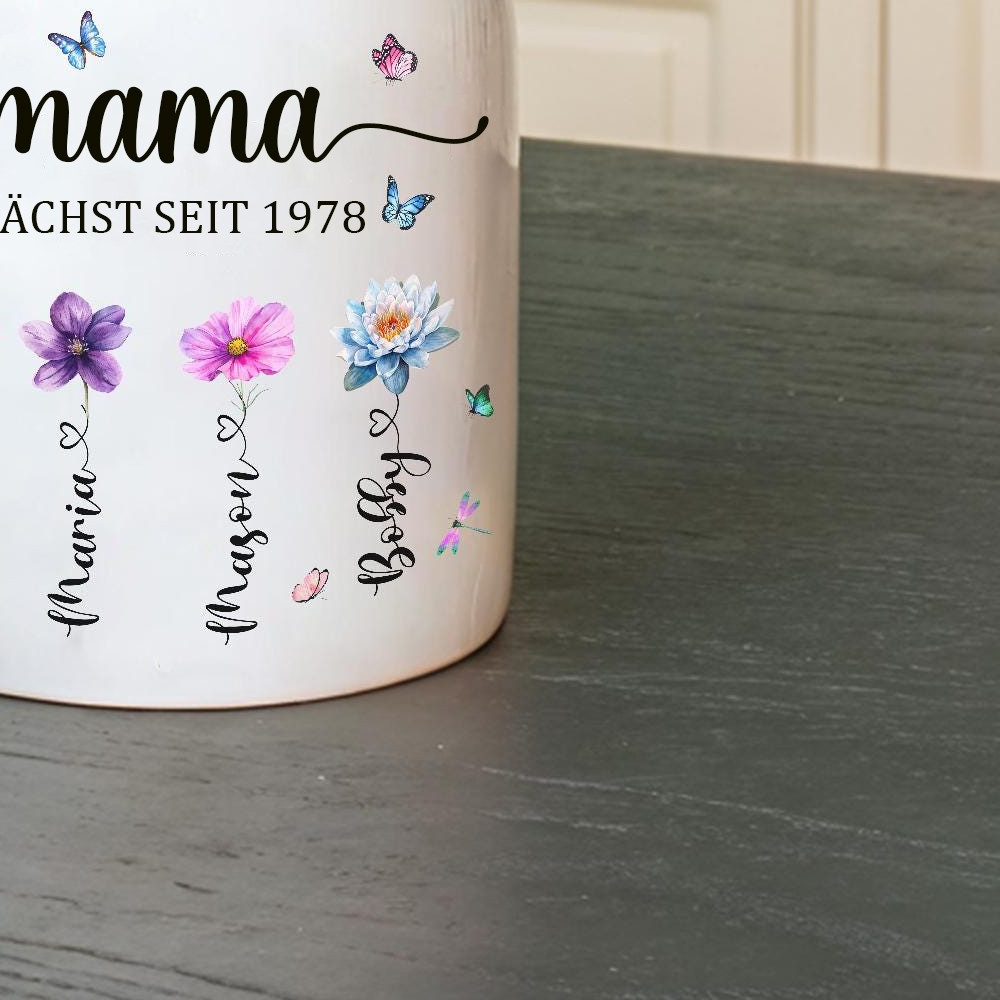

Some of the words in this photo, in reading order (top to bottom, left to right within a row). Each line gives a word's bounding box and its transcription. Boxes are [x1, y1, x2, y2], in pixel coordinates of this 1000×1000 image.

[155, 200, 249, 234] SEIT
[264, 200, 366, 234] 1978
[47, 467, 102, 638] Maria
[205, 459, 270, 646] Mason
[356, 450, 432, 597] Bobby
